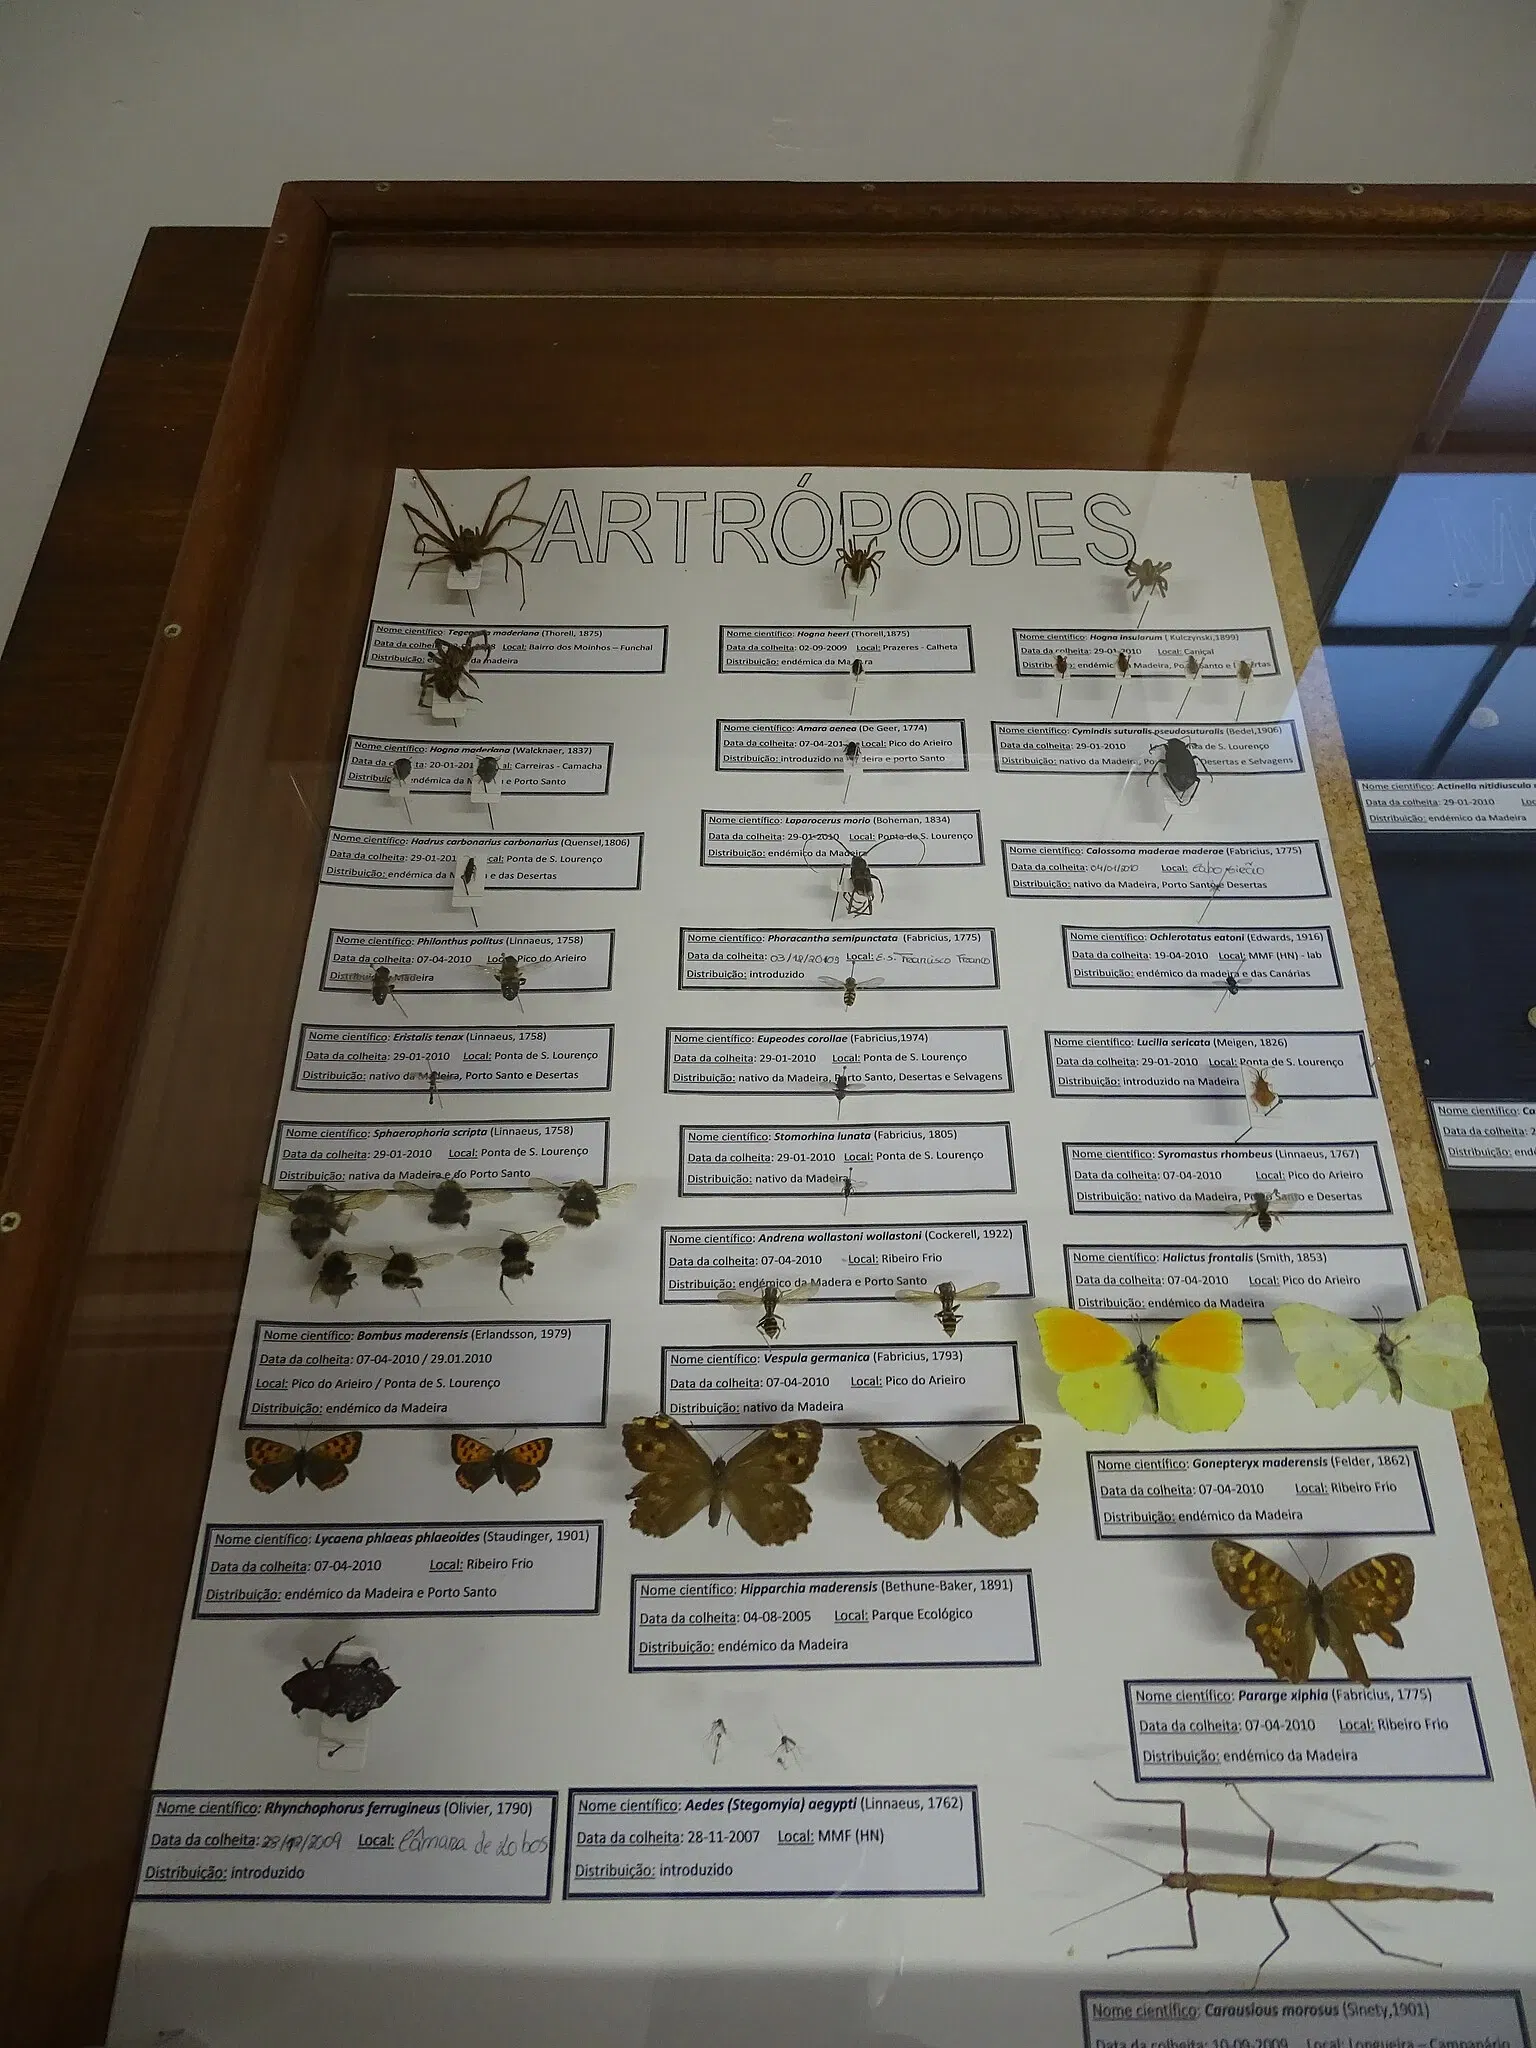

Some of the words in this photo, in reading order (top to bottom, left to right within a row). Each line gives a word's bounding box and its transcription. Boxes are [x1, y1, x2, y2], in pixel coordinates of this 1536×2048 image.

[530, 472, 1137, 566] ARTRÓPODES
[726, 630, 752, 638] Nome
[753, 630, 795, 638] científico:
[797, 630, 825, 638] Hogna
[851, 630, 910, 638] (Thorell,1875)
[752, 725, 795, 733] científico:
[858, 725, 874, 733] (De
[876, 725, 900, 733] Geer,
[903, 725, 927, 733] 1774)
[354, 742, 382, 752] Nome
[383, 743, 427, 754] científico:
[429, 745, 460, 755] Hogna
[461, 745, 511, 755] maderiana
[568, 746, 592, 756] 1837)
[1361, 783, 1389, 791] Nome
[1391, 783, 1435, 791] científico:
[1436, 783, 1476, 791] Actinella
[1368, 815, 1426, 823] Distribuição:
[1488, 814, 1527, 822] Madeira
[332, 833, 361, 844] Nome
[363, 835, 408, 846] científico:
[410, 837, 444, 846] Hadrus
[446, 837, 502, 846] carbonarius
[503, 837, 559, 846] carbonarius
[560, 837, 630, 848] (Quensel,1806)
[687, 934, 716, 944] Nome
[718, 934, 765, 944] científico:
[767, 934, 830, 943] Phoracantha
[831, 934, 898, 944] semipunctata
[903, 933, 951, 944] (Fabricius,
[954, 933, 981, 944] 1775)
[1070, 932, 1098, 942] Nome
[1100, 932, 1147, 943] científico:
[1149, 933, 1211, 942] Ochlerotatus
[1213, 933, 1244, 942] eatoni
[1246, 933, 1293, 944] (Edwards,
[1296, 933, 1323, 944] 1916)
[686, 970, 746, 980] Distribuição:
[749, 970, 805, 979] introduzido
[674, 1034, 704, 1045] Nome
[706, 1034, 754, 1045] científico:
[757, 1034, 805, 1045] Eupeodes
[807, 1033, 848, 1044] corollae
[850, 1033, 928, 1045] (Fabricius,1974)
[1053, 1037, 1083, 1048] Nome
[1086, 1037, 1134, 1049] científico:
[1136, 1037, 1168, 1048] Lucilia
[1170, 1037, 1210, 1048] sericata
[1213, 1037, 1257, 1049] (Meigen,
[1260, 1037, 1287, 1049] 1826)
[286, 1129, 317, 1140] Nome
[320, 1129, 370, 1140] científico:
[373, 1127, 450, 1140] Sphaerophoria
[451, 1127, 488, 1139] scripta
[490, 1126, 541, 1138] (Linnaeus,
[544, 1125, 573, 1138] 1758)
[1072, 1149, 1102, 1161] Nome
[1105, 1149, 1155, 1161] científico:
[1157, 1150, 1218, 1162] Syromastus
[1220, 1149, 1272, 1160] rhombeus
[1275, 1149, 1326, 1161] (Linnaeus,
[1331, 1148, 1359, 1160] 1767)
[669, 1234, 701, 1246] Nome
[704, 1233, 755, 1246] científico:
[757, 1232, 805, 1244] Andrena
[807, 1231, 864, 1243] wollastoni
[866, 1230, 922, 1242] wollastoni
[924, 1229, 980, 1243] (Cockerell,
[983, 1229, 1013, 1242] 1922)
[264, 1330, 297, 1343] Nome
[300, 1329, 354, 1342] científico:
[356, 1329, 402, 1341] Bombus
[404, 1329, 468, 1341] maderensis
[471, 1328, 537, 1342] (Erlandsson,
[541, 1328, 571, 1342] 1979)
[259, 1353, 286, 1366] Data
[288, 1353, 303, 1366] da
[305, 1353, 353, 1366] colheita:
[356, 1353, 420, 1365] 07-04-2010
[430, 1352, 492, 1364] 29.01.2010
[670, 1353, 703, 1366] Nome
[706, 1352, 760, 1366] científico:
[764, 1351, 808, 1365] Vespula
[810, 1352, 870, 1365] germanica
[873, 1350, 928, 1364] (Fabricius,
[932, 1350, 963, 1364] 1793)
[1097, 1458, 1131, 1472] Nome
[1134, 1457, 1189, 1471] científico:
[1192, 1457, 1259, 1471] Gonepteryx
[1262, 1456, 1328, 1468] maderensis
[1330, 1455, 1374, 1469] (Felder,
[1377, 1454, 1410, 1469] 1862)
[215, 1533, 251, 1547] Nome
[254, 1533, 311, 1547] científico:
[314, 1532, 363, 1547] Lycaena
[365, 1531, 413, 1547] phlaeas
[414, 1531, 480, 1546] phlaeoides
[483, 1530, 552, 1545] (Staudinger,
[557, 1529, 589, 1545] 1901)
[206, 1587, 281, 1603] Distribuição:
[284, 1586, 343, 1600] endémico
[346, 1586, 361, 1599] da
[364, 1586, 414, 1599] Madeira
[416, 1589, 424, 1599] e
[427, 1585, 460, 1599] Porto
[462, 1585, 497, 1599] Santo
[640, 1583, 676, 1598] Nome
[679, 1582, 737, 1598] científico:
[740, 1581, 806, 1598] Hipparchia
[808, 1581, 878, 1595] maderensis
[881, 1579, 976, 1596] (Bethune-Baker,
[980, 1579, 1013, 1595] 1891)
[1135, 1690, 1172, 1703] Nome
[1175, 1689, 1234, 1703] científico:
[1238, 1689, 1287, 1704] Pararge
[1290, 1689, 1328, 1703] xiphia
[1331, 1688, 1394, 1703] (Fabricius,
[1397, 1688, 1432, 1703] 1775)
[156, 1801, 196, 1816] Nome
[199, 1801, 261, 1816] científico:
[264, 1801, 364, 1818] Rhynchophorus
[367, 1801, 440, 1818] ferrugineus
[443, 1802, 492, 1818] (Olivier,
[497, 1802, 532, 1818] 1790)
[578, 1800, 616, 1815] Nome
[620, 1799, 681, 1814] científico:
[684, 1798, 724, 1812] Aedes
[727, 1798, 805, 1814] (Stegomyia)
[807, 1797, 857, 1813] aegypti
[860, 1797, 923, 1813] (Linnaeus,
[928, 1796, 963, 1812] 1762)
[577, 1831, 606, 1846] Data
[609, 1831, 625, 1846] da
[629, 1830, 684, 1846] colheita:
[687, 1829, 760, 1844] 28-11-2007
[778, 1830, 814, 1846] Local:
[818, 1830, 851, 1844] MMF
[855, 1829, 884, 1845] (HN)
[575, 1863, 655, 1880] Distribuição:
[659, 1863, 733, 1877] introduzido
